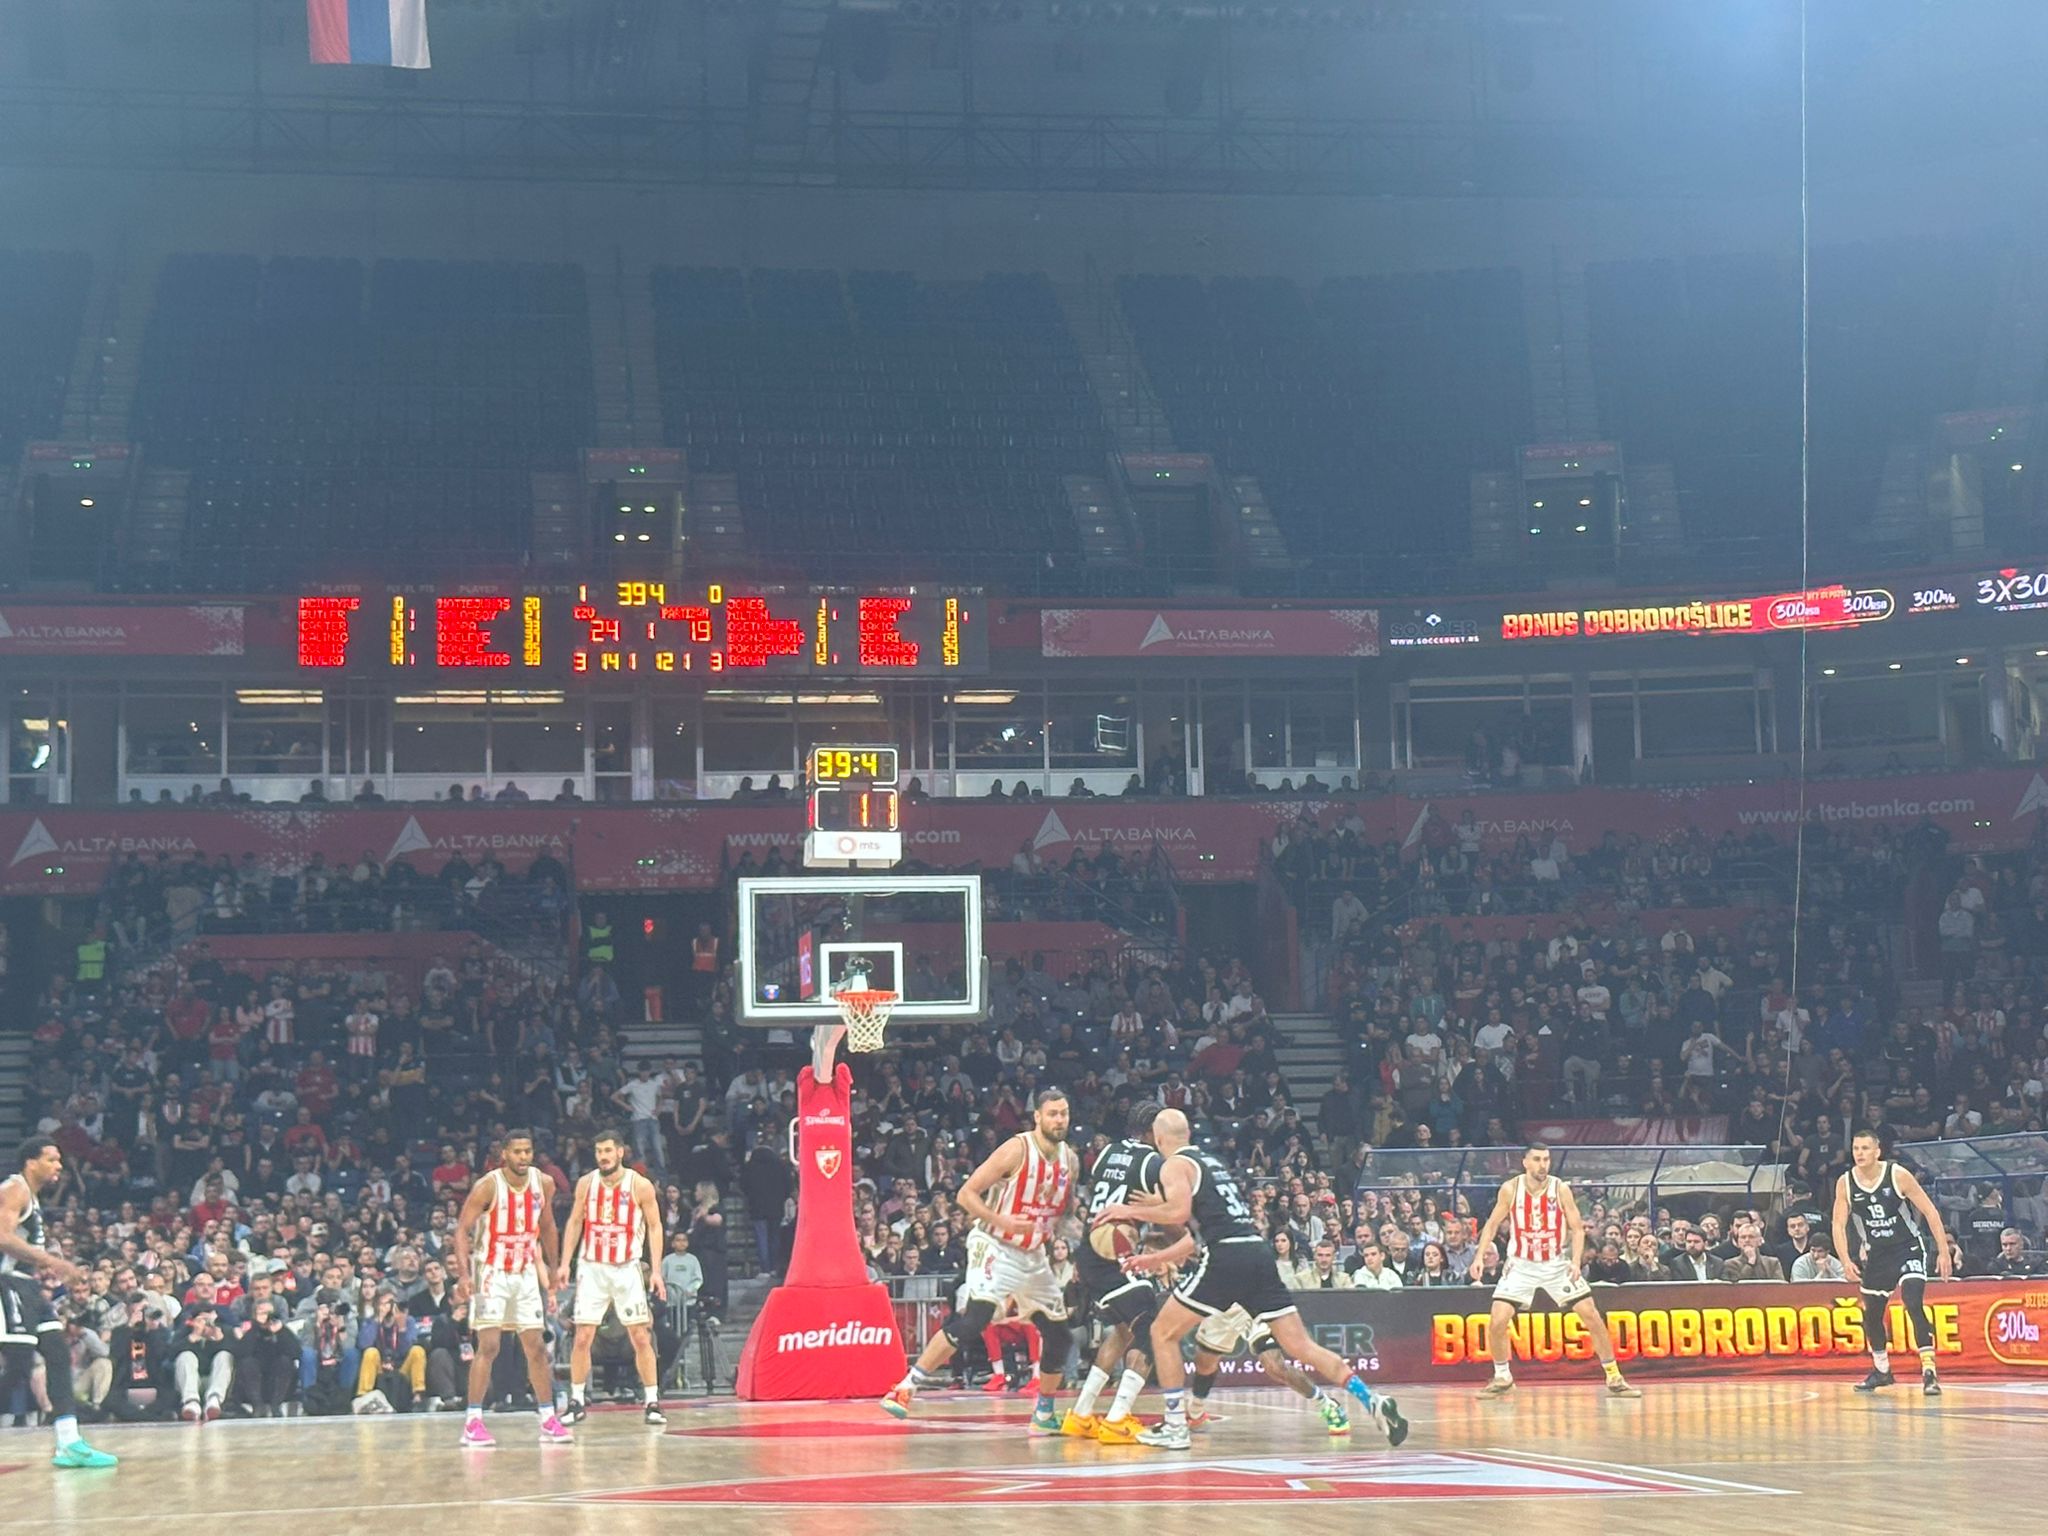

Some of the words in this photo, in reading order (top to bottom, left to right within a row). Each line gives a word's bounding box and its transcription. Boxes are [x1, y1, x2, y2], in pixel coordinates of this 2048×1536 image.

[709, 585, 721, 603] 0
[1913, 588, 1956, 607] 300%
[1502, 611, 1579, 639] BONUS
[1583, 601, 1753, 636] DOBRODOŠLICE
[17, 626, 127, 638] ALTABANKA
[591, 620, 619, 642] 24
[692, 621, 711, 641] 19
[1175, 629, 1275, 641] ALTABANKA
[575, 653, 587, 671] 3
[602, 653, 619, 671] 14
[655, 653, 673, 671] 12
[711, 653, 722, 671] 3
[435, 834, 564, 849] ALTABANKA
[1073, 828, 1197, 841] ALTABANKA
[63, 837, 197, 852] ALTABANKA
[859, 841, 881, 850] mts
[1103, 1168, 1126, 1181] mts
[1089, 1181, 1128, 1213] 24
[1867, 1204, 1885, 1219] 19
[1906, 1259, 1923, 1272] 19
[635, 1303, 647, 1316] 12
[778, 1320, 892, 1353] meridian
[1431, 1310, 1596, 1365] BONUS
[1605, 1297, 1963, 1362] DOBRODOŠIE
